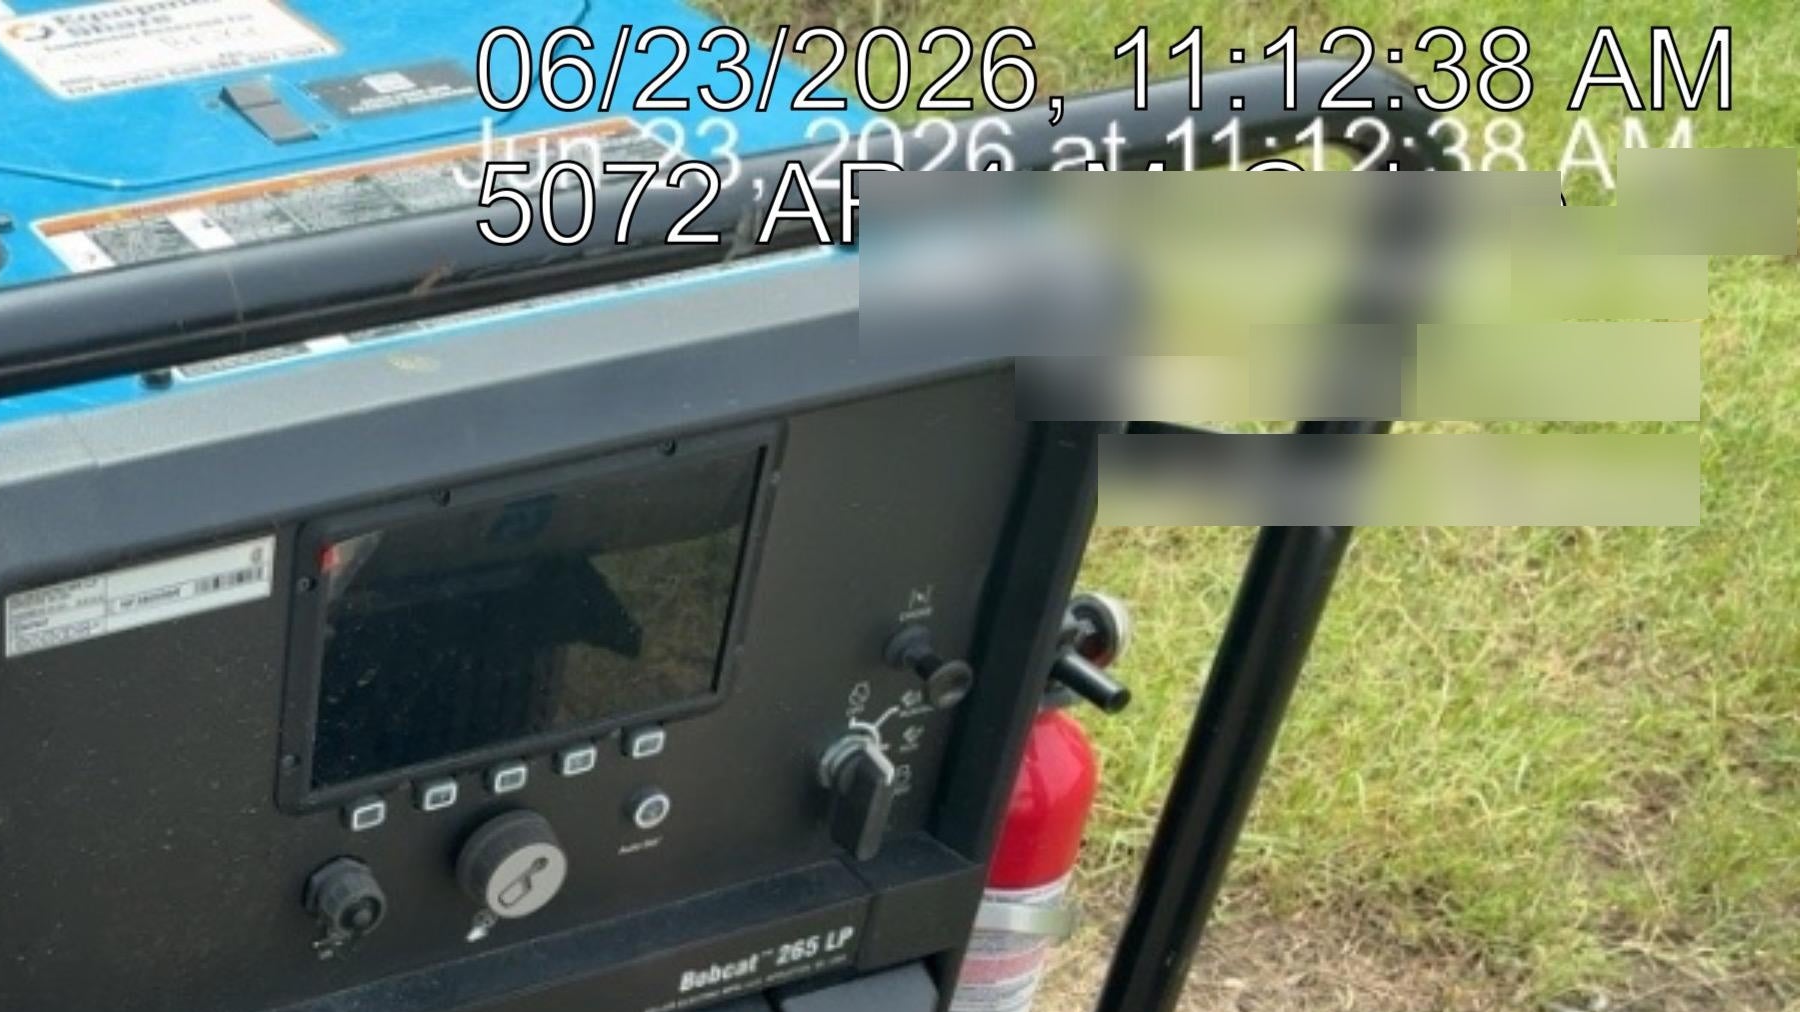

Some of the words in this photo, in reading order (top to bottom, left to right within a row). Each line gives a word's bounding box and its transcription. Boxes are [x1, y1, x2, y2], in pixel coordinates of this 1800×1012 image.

[679, 953, 759, 991] Bobcat
[775, 935, 820, 967] 265
[824, 925, 855, 951] LP
